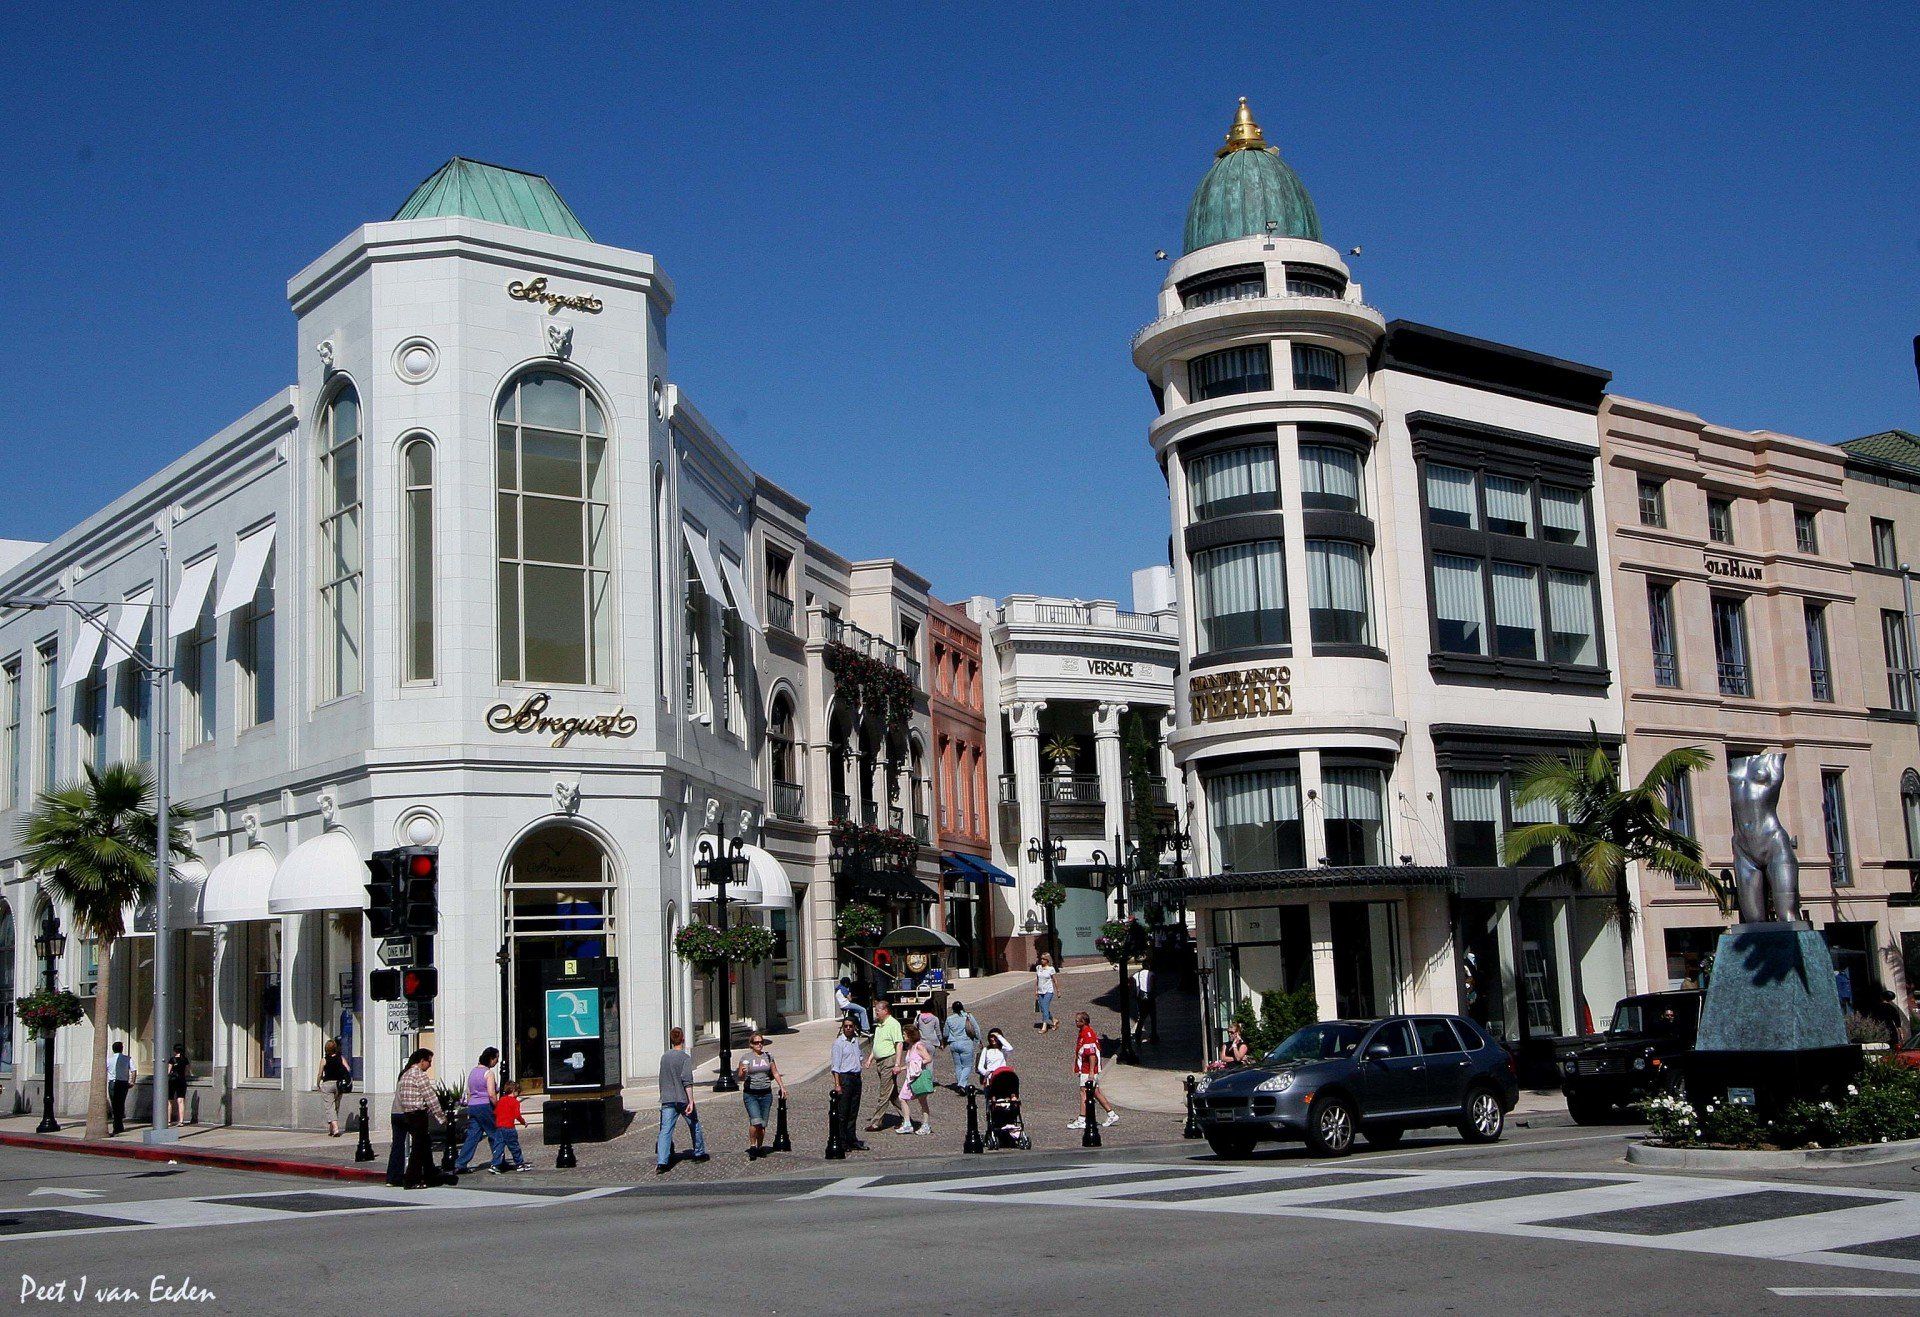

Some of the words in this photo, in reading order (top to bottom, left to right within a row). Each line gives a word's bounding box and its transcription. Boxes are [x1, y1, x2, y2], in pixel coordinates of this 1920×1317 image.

[508, 277, 604, 316] Breguet
[1087, 660, 1134, 678] VERSACE
[1189, 665, 1291, 693] GIANFRANCO
[1190, 685, 1293, 726] FERRE
[487, 692, 638, 749] Breguet
[388, 946, 398, 957] ONE
[388, 1021, 399, 1031] OK
[752, 1059, 768, 1067] LA
